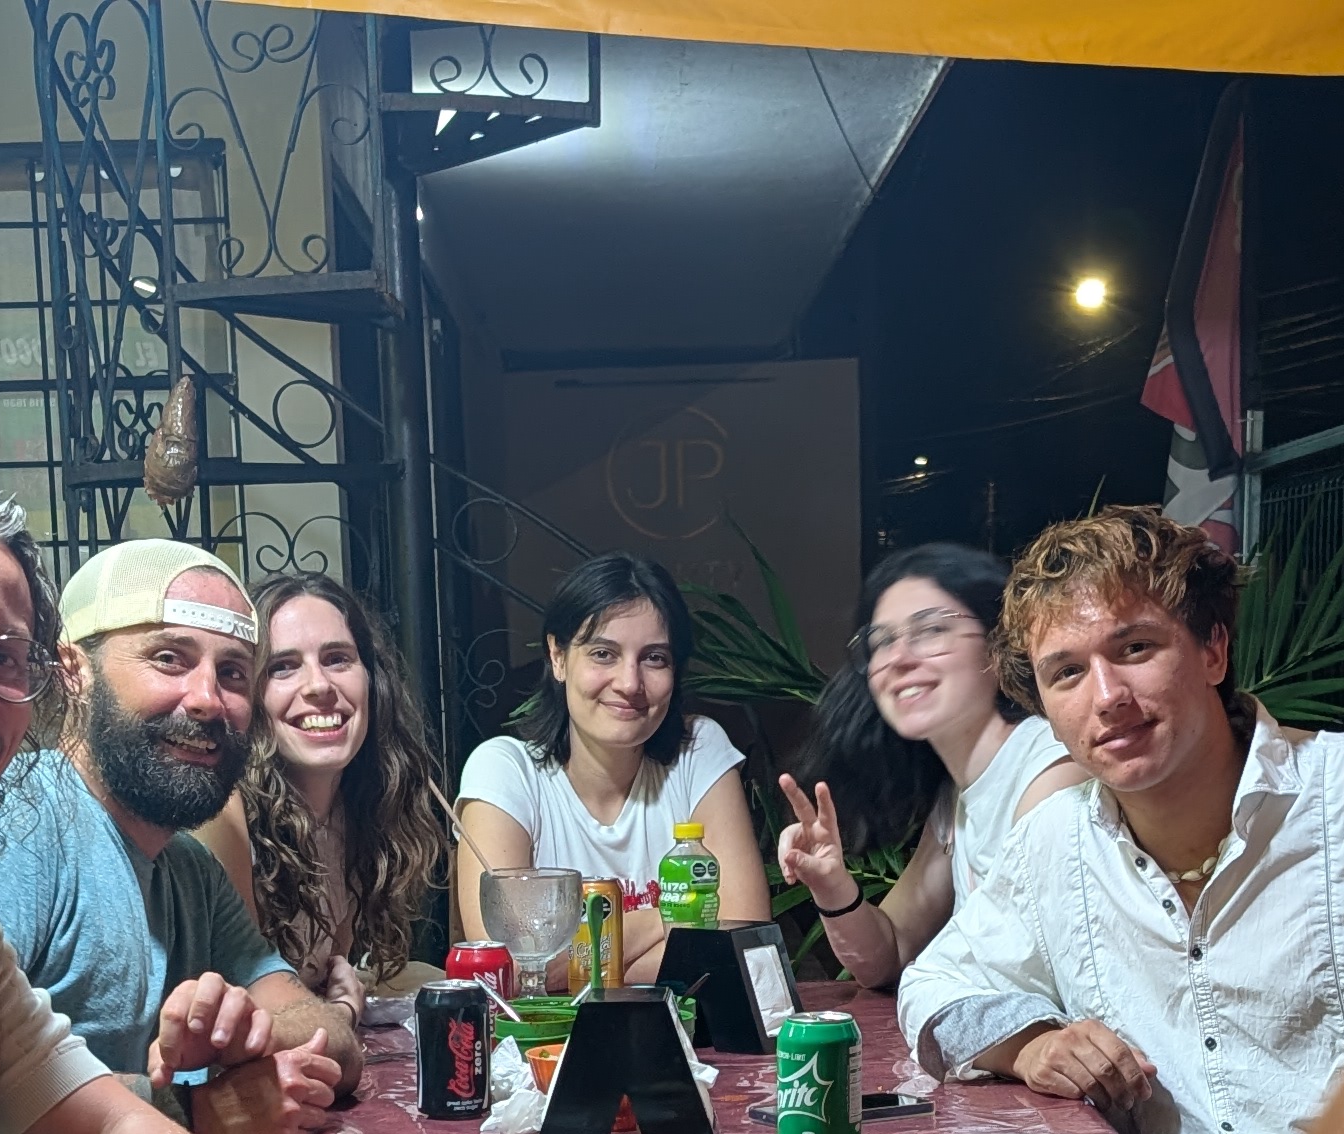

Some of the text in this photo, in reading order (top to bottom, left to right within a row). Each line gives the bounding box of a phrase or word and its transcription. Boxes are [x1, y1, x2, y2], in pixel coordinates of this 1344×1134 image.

[447, 1016, 476, 1098] Coca-Cola
[474, 1040, 483, 1076] zero
[777, 1079, 819, 1109] prite
